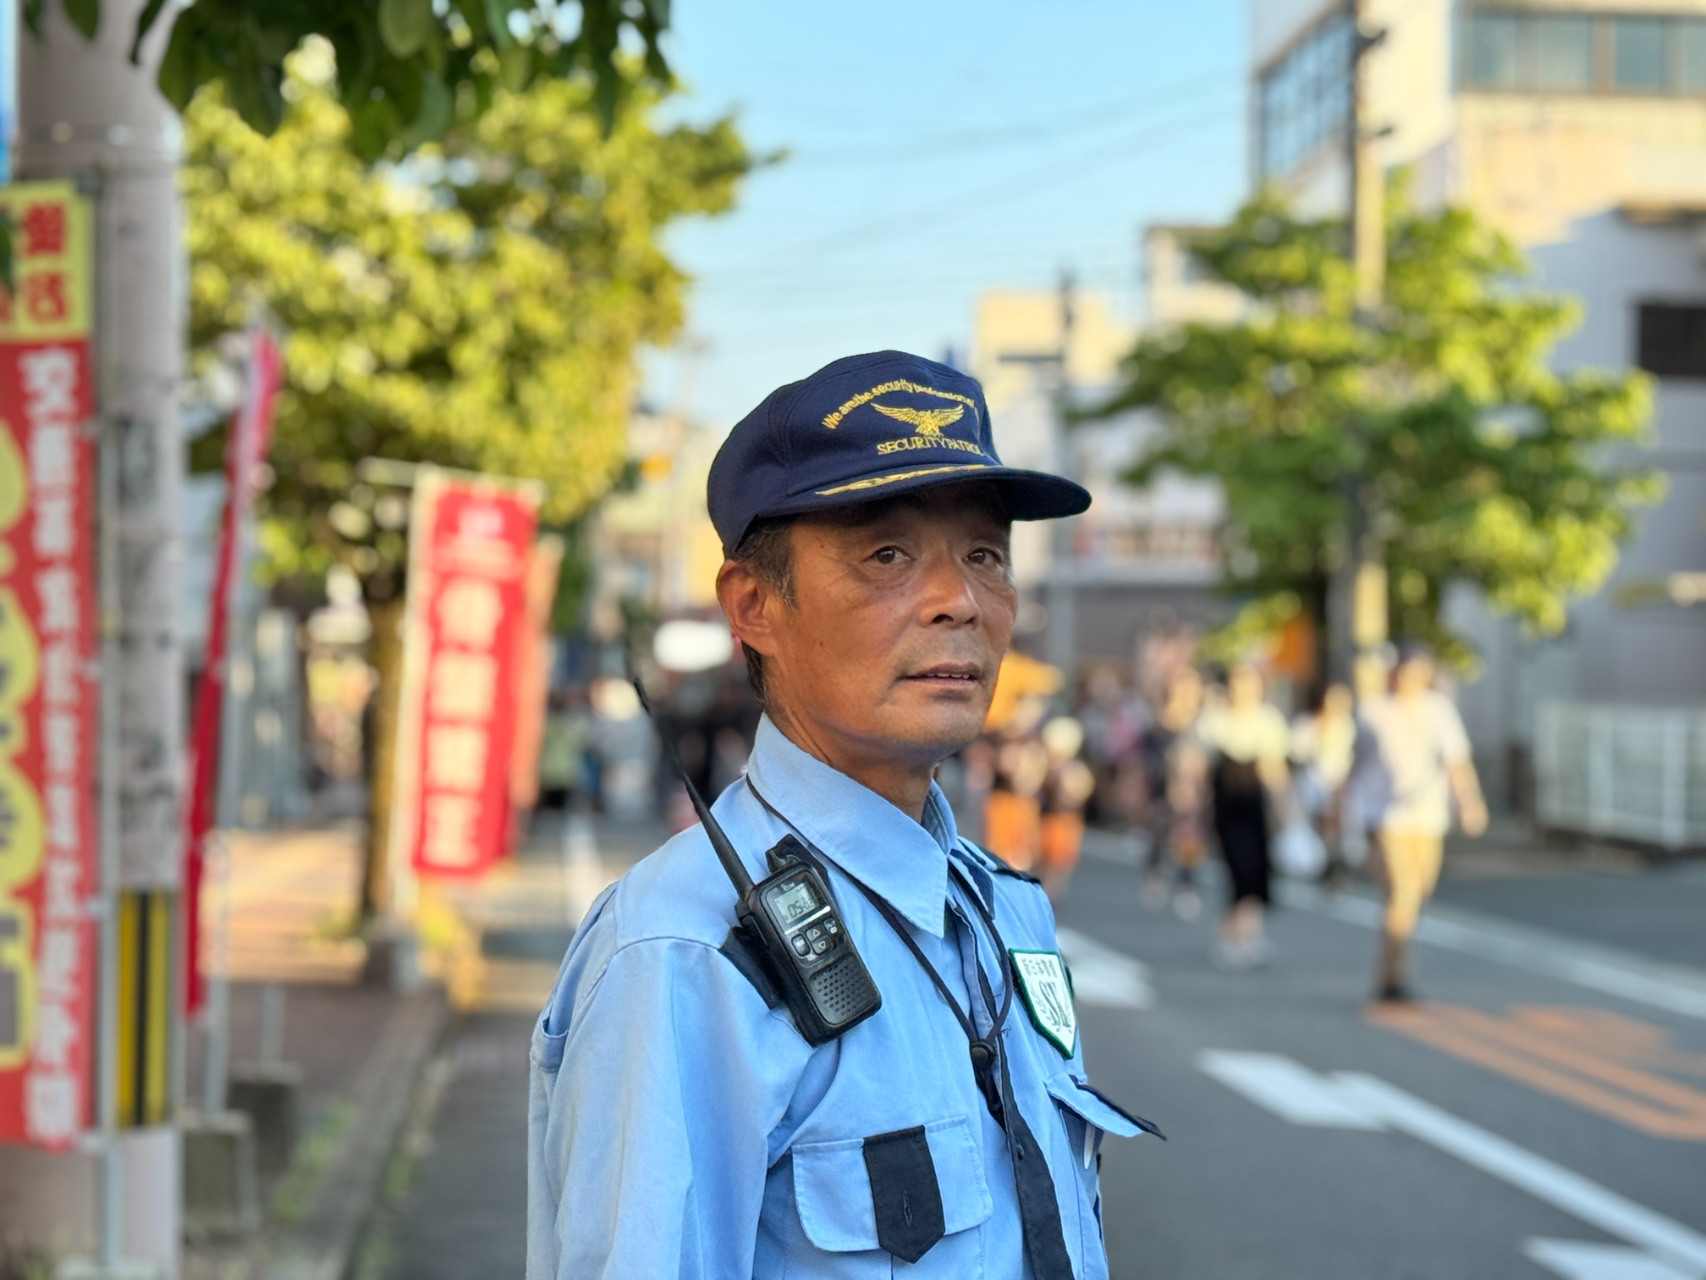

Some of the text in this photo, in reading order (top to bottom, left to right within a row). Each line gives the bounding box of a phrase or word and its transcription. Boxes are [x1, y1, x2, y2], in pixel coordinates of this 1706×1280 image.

[822, 413, 843, 429] We
[871, 379, 913, 398] security
[877, 437, 985, 456] SECURITY PATROL
